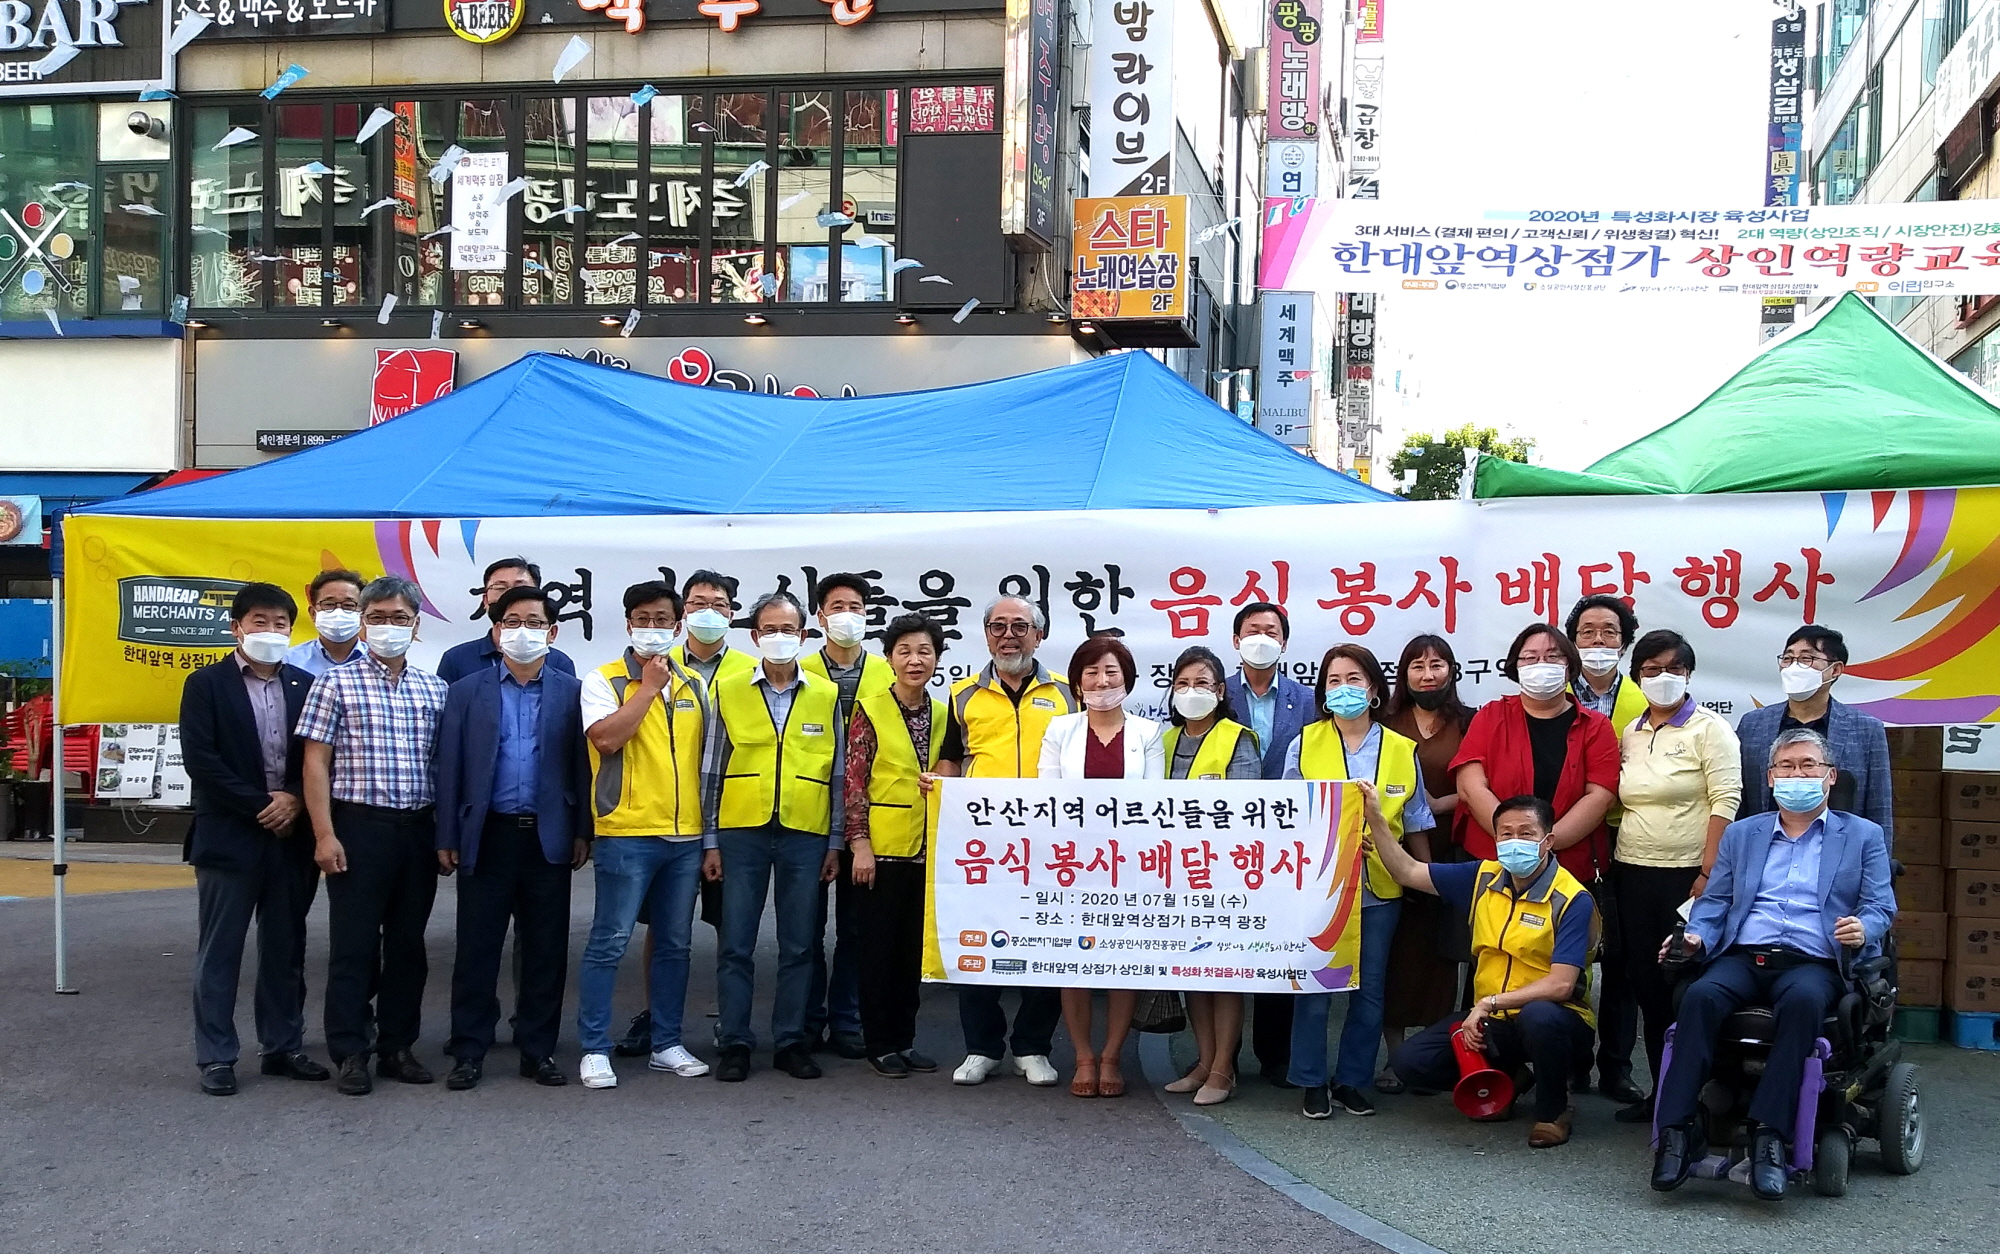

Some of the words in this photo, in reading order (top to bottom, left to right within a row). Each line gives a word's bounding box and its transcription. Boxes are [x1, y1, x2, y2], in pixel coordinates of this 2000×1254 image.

[0, 0, 124, 49] BAR
[1280, 42, 1309, 131] 노래방
[1773, 58, 1800, 115] 생삼겹
[1354, 104, 1380, 149] 곱창
[1139, 172, 1167, 195] 2F
[1528, 209, 1600, 224] 2020년
[1610, 209, 1721, 224] 특성화시장
[1723, 208, 1810, 224] 육성사업
[1090, 209, 1171, 250] 스타
[1354, 225, 1380, 237] 3대
[1383, 226, 1431, 238] 서비스
[1476, 227, 1508, 239] 편의
[1522, 228, 1588, 240] 고객신뢰
[1679, 228, 1719, 241] 혁신!
[1737, 228, 1764, 240] 2대
[1331, 241, 1670, 278] 한대앞역상점가
[1078, 253, 1180, 290] 노래연습장
[1152, 294, 1174, 312] 2F
[1277, 304, 1296, 387] 세계맥주
[1347, 366, 1372, 379] MS
[1262, 408, 1306, 417] MALIBU
[1275, 424, 1293, 436] 3F
[258, 434, 300, 446] 체인점문의
[1150, 560, 1291, 639] 음식
[1317, 555, 1473, 636] 봉사
[1673, 547, 1836, 630] 행사
[133, 605, 215, 621] MERCHANTS
[170, 626, 197, 635] SINCE
[198, 627, 215, 636] 2017
[124, 645, 174, 668] 한대앞역
[966, 796, 1084, 829] 안산지역
[1094, 796, 1235, 830] 어르신들을
[1241, 797, 1299, 830] 위한
[954, 838, 1031, 887] 음식
[1044, 838, 1126, 889] 봉사
[1138, 839, 1221, 890] 배달
[1229, 840, 1312, 891] 행사
[1035, 891, 1064, 906] 일시
[1081, 892, 1119, 906] 2020
[1124, 892, 1137, 907] 년
[1142, 893, 1177, 908] 07월
[1183, 893, 1215, 908] 15일
[1220, 893, 1248, 909] (수)
[1035, 911, 1064, 926] 장소
[1081, 912, 1186, 929] 한대앞역상점가
[1191, 914, 1232, 930] B구역
[1236, 914, 1267, 930] 광장
[963, 934, 983, 944] 주최
[1010, 936, 1073, 949] 중소벤처기업부
[1099, 936, 1187, 951] 소상공인시장진흥공단
[962, 958, 982, 969] 주관
[1031, 961, 1078, 975] 한대앞역
[1081, 962, 1117, 976] 상점가
[1119, 964, 1155, 977] 상인회
[1170, 966, 1201, 978] 특성화
[1203, 966, 1255, 979] 첫걸음시장
[1256, 968, 1307, 980] 육성사업단
